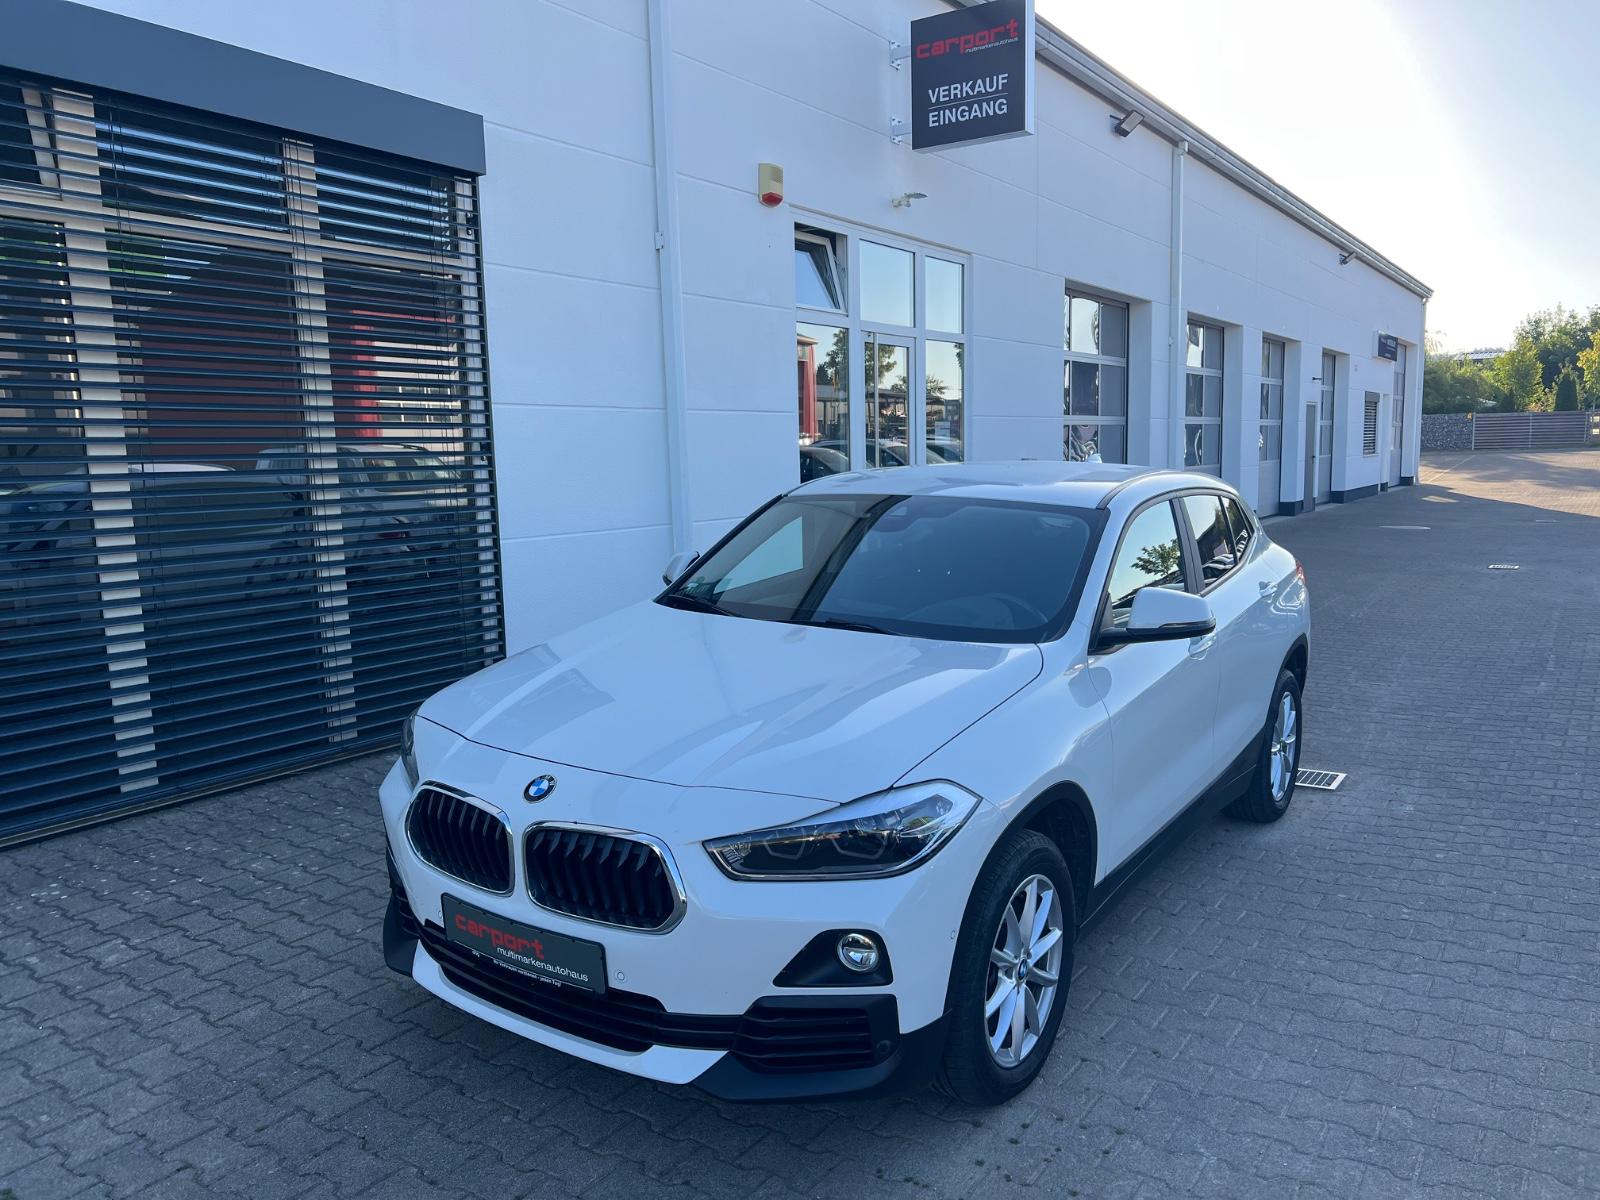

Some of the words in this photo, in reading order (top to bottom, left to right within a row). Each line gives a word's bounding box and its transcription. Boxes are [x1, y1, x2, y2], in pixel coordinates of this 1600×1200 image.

[915, 18, 1018, 58] carport
[928, 73, 1009, 103] VERKAUF
[928, 98, 1008, 127] EINGANG
[455, 913, 544, 960] carport
[497, 946, 589, 982] multimarkenautohaus
